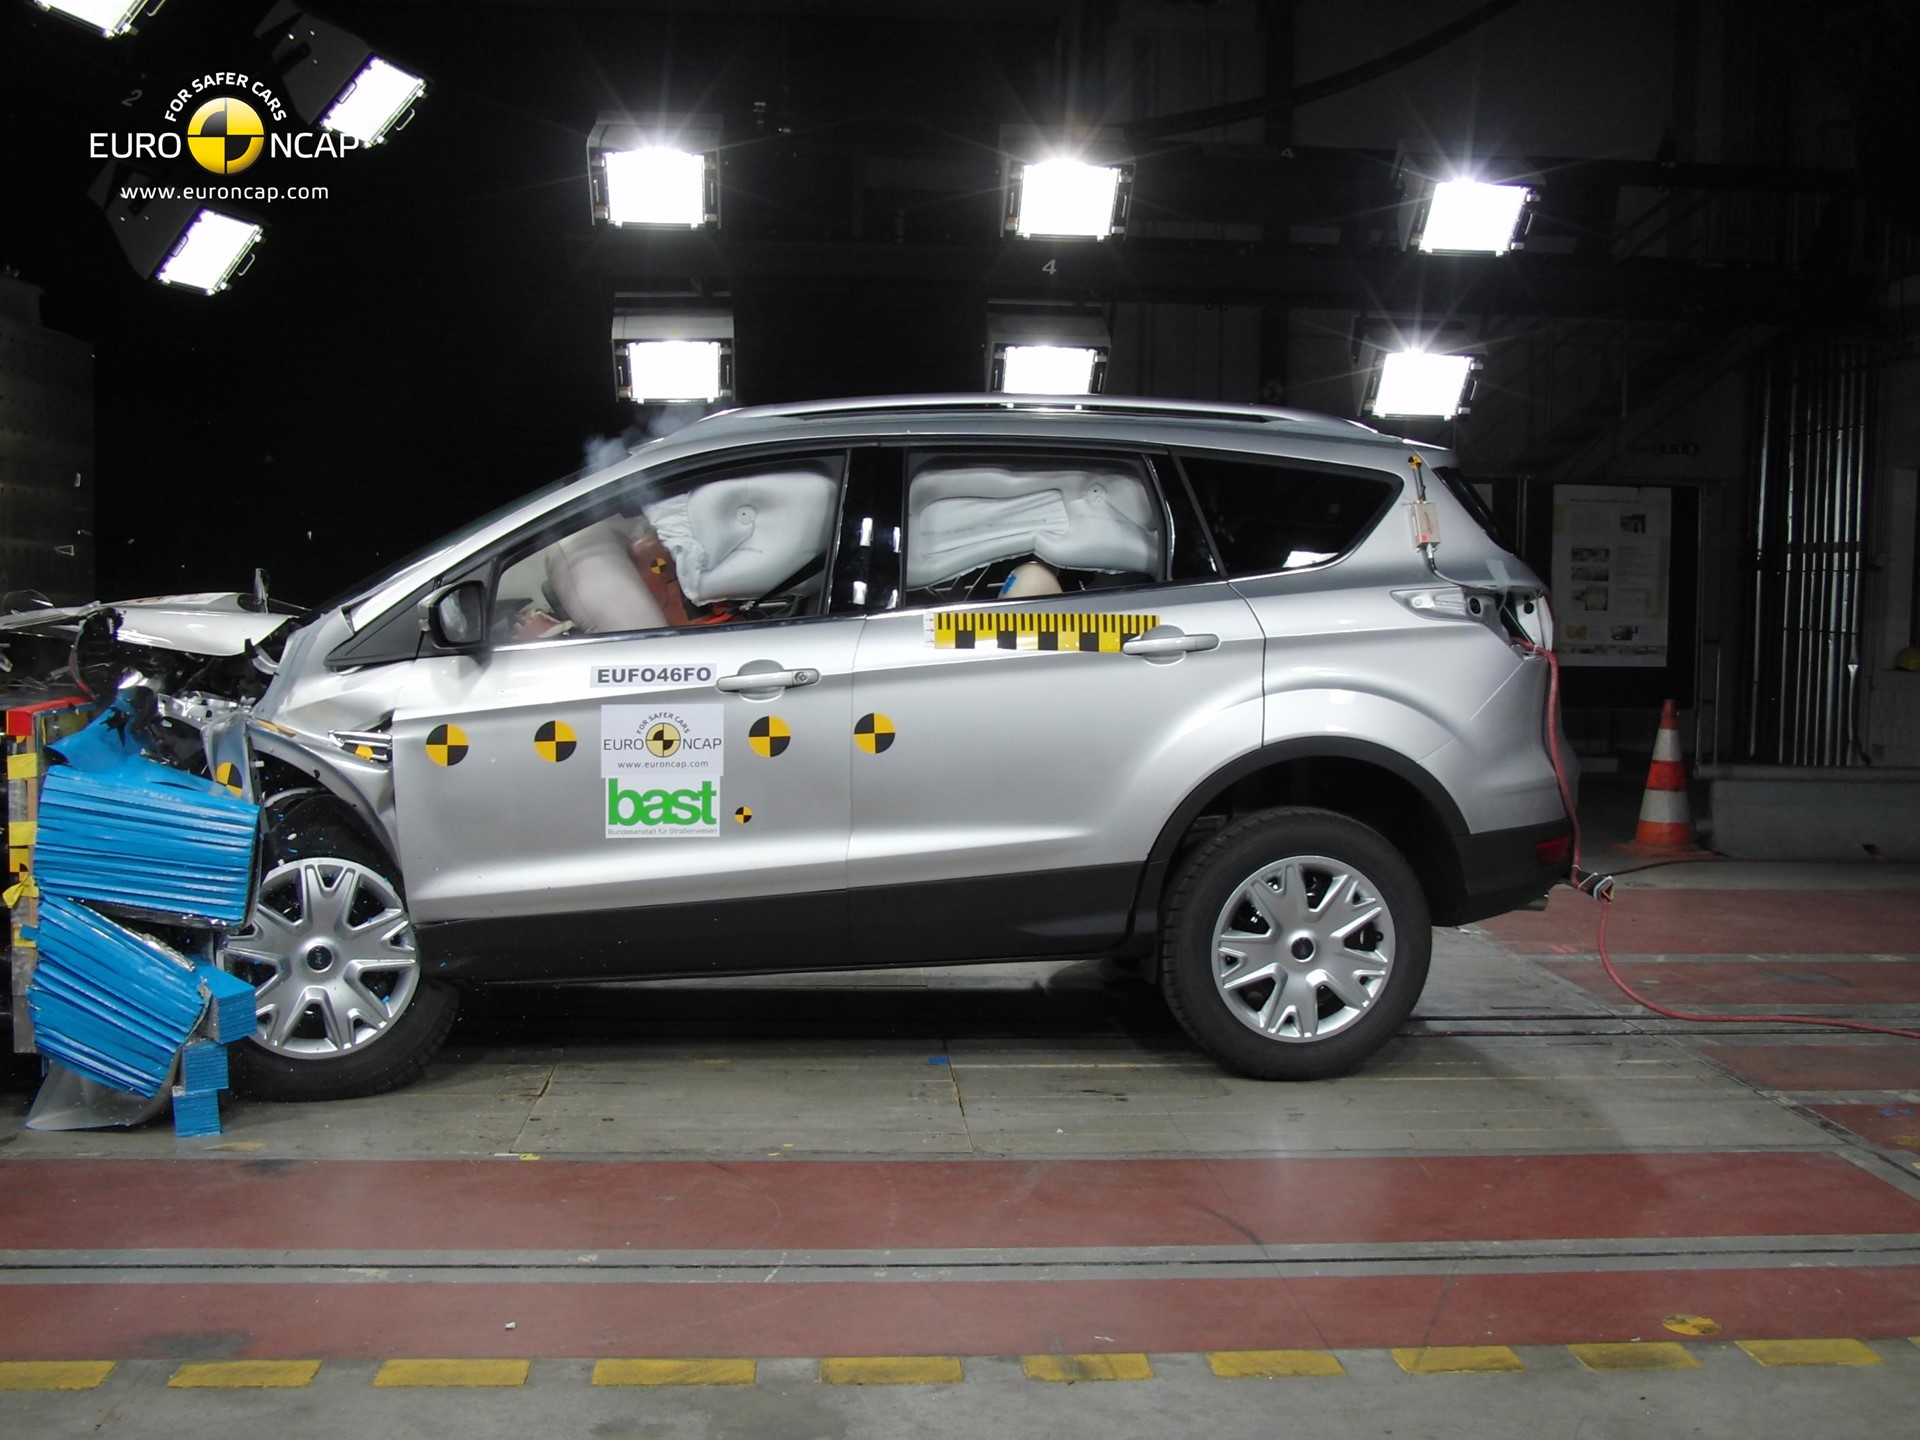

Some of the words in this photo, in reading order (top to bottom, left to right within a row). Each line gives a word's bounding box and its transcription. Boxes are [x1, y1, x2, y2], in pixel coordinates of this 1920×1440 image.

[121, 89, 143, 107] 2
[1042, 259, 1057, 275] 4
[637, 720, 648, 734] FOR
[648, 712, 674, 721] SAFER
[674, 716, 690, 733] CARS
[603, 738, 644, 751] EURO
[682, 738, 722, 750] NCAP
[617, 760, 709, 768] www.euroncap.com
[608, 778, 717, 826] bast
